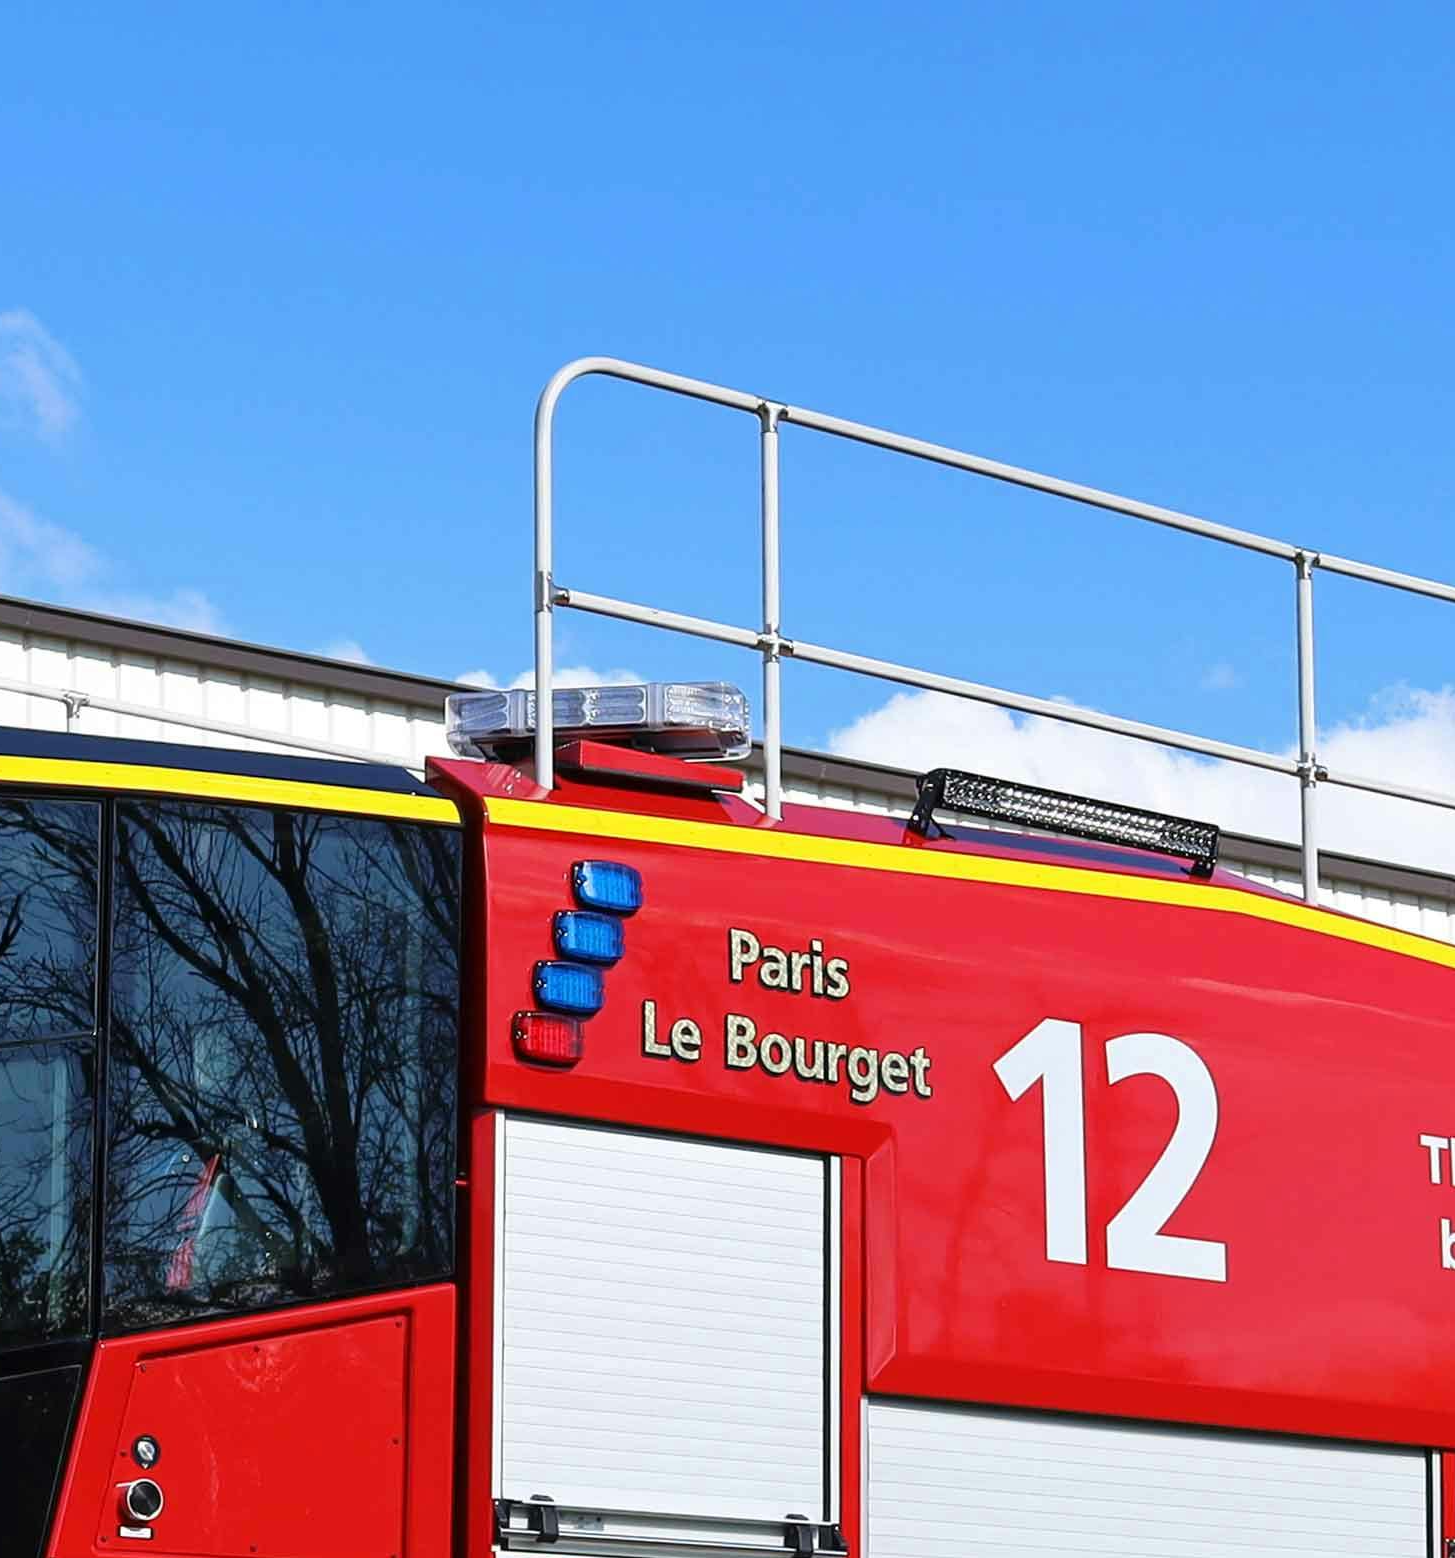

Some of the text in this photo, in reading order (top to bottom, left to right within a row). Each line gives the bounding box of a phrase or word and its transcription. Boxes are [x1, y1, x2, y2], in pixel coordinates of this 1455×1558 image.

[729, 928, 850, 998] Paris
[641, 999, 933, 1103] Le Bourget
[992, 1017, 1227, 1283] 12
